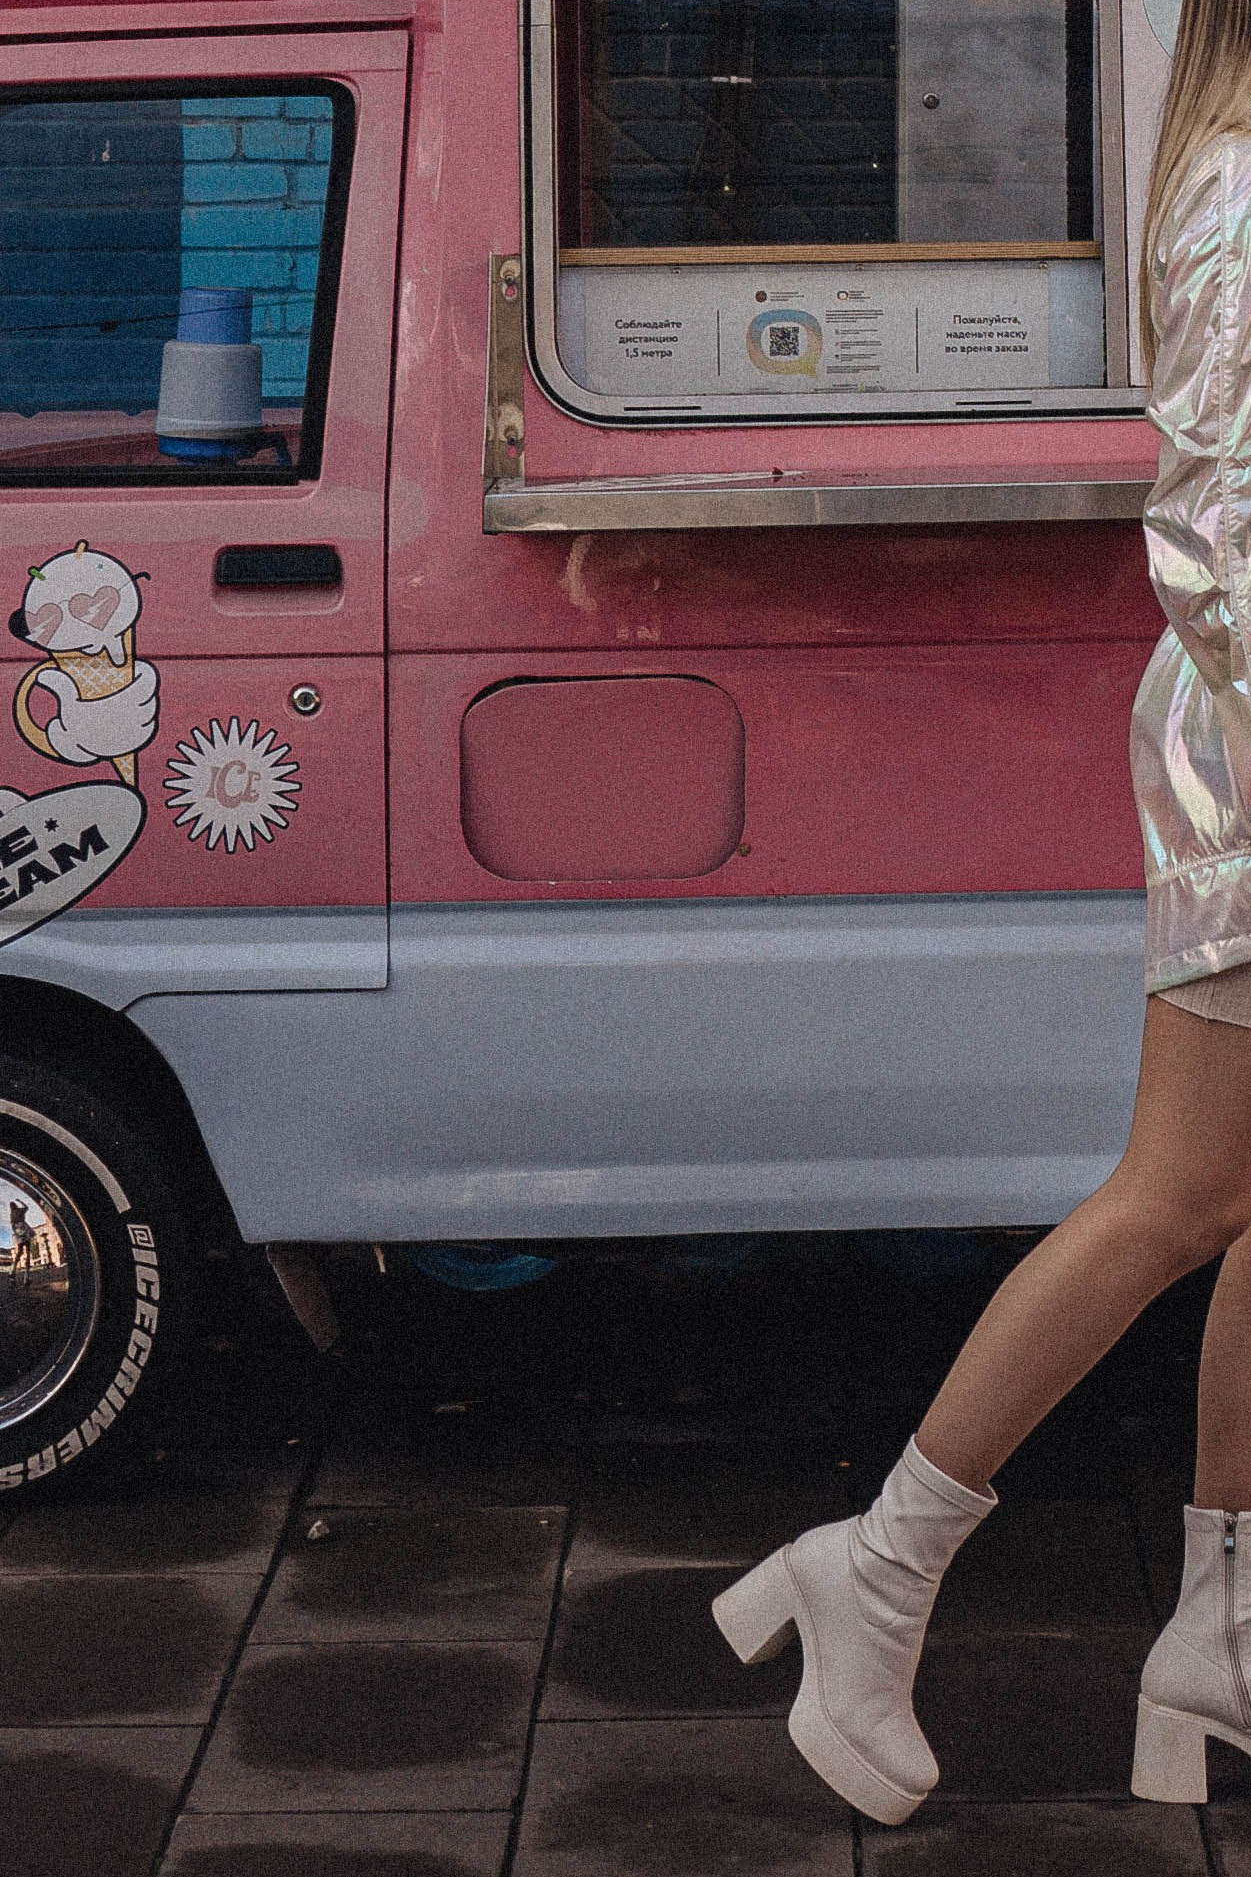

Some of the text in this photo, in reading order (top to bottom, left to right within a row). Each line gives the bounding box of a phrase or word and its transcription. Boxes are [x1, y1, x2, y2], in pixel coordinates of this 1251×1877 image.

[614, 319, 682, 330] Соблюдайте
[953, 314, 1021, 326] Пожалуйста,
[618, 336, 678, 345] дистанцию
[625, 347, 673, 359] 1,5 метра
[945, 345, 958, 353] во
[995, 345, 1029, 353] заказа
[205, 759, 261, 810] ICE
